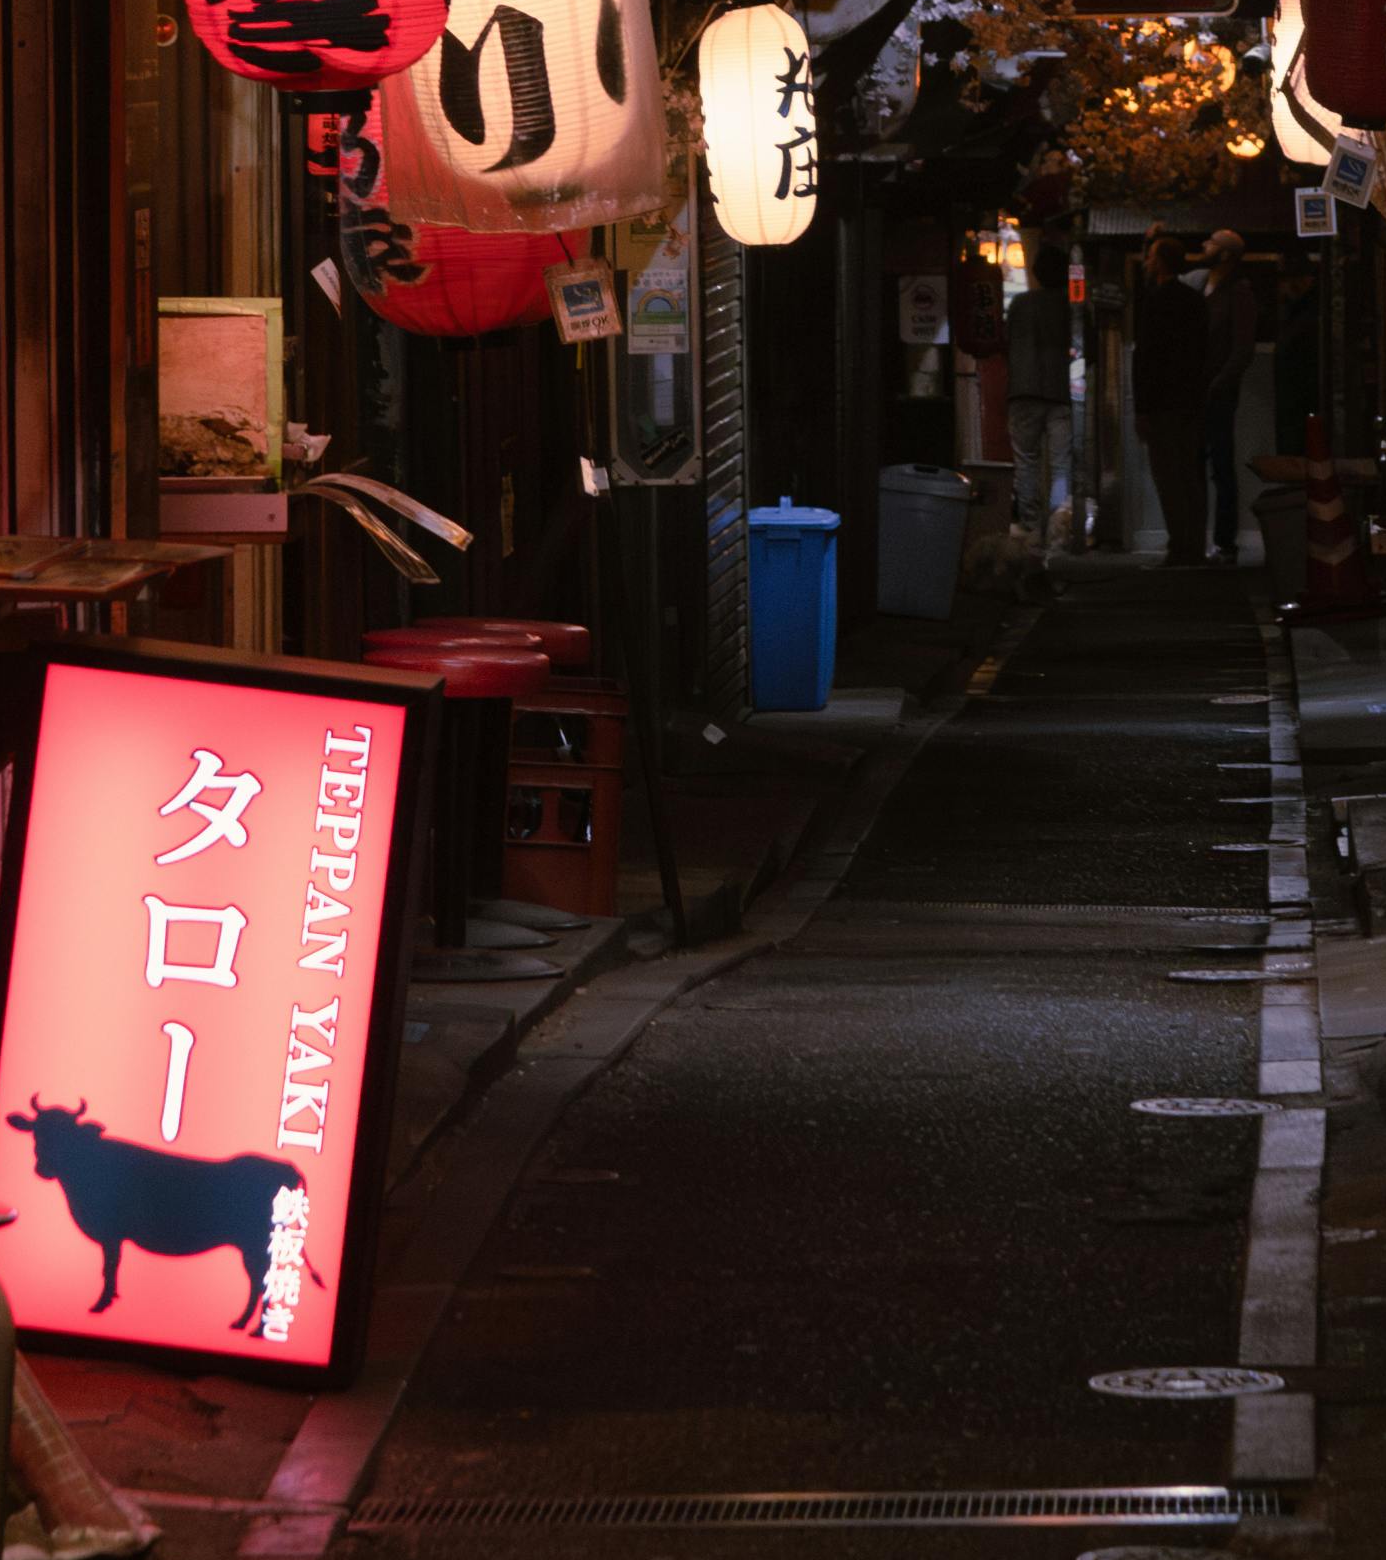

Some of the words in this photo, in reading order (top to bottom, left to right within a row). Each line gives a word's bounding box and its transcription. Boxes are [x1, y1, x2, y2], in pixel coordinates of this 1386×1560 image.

[144, 748, 262, 1143] タロー
[297, 725, 373, 978] TEPPAN
[275, 995, 341, 1155] YAKI
[261, 1185, 310, 1344] 鉄板焼き
